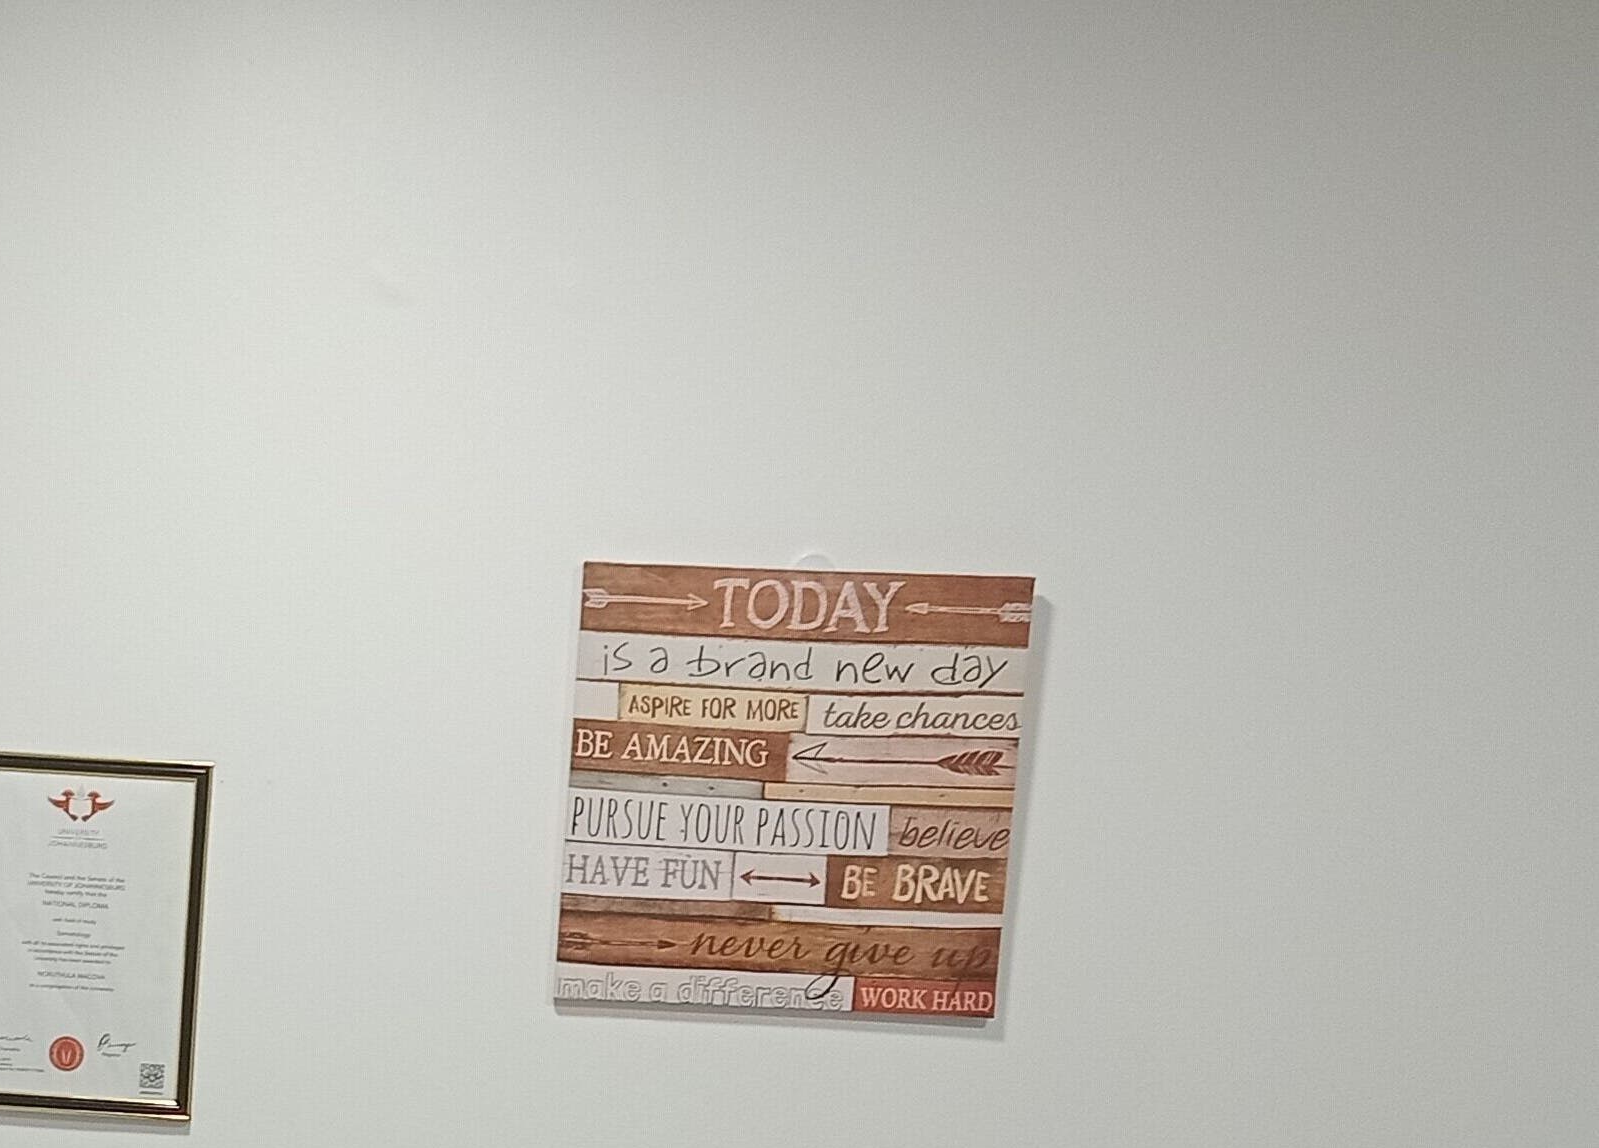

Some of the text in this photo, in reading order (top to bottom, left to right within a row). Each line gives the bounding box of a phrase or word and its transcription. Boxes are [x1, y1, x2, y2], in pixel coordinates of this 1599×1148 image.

[714, 578, 906, 633] TODAY
[604, 642, 1008, 688] is a brand new day
[628, 695, 799, 722] ASPIRE FOR MORE
[823, 701, 1023, 732] take chances
[574, 728, 769, 768] BE AMAZING
[571, 796, 877, 851] PURSUE YOUR PASSION
[898, 815, 1011, 851] believe
[565, 854, 722, 890] HAVE FUN
[840, 863, 992, 905] BE BRAVE
[690, 932, 812, 960] never
[556, 972, 845, 1010] make a difference
[859, 986, 993, 1013] WORK HARD
